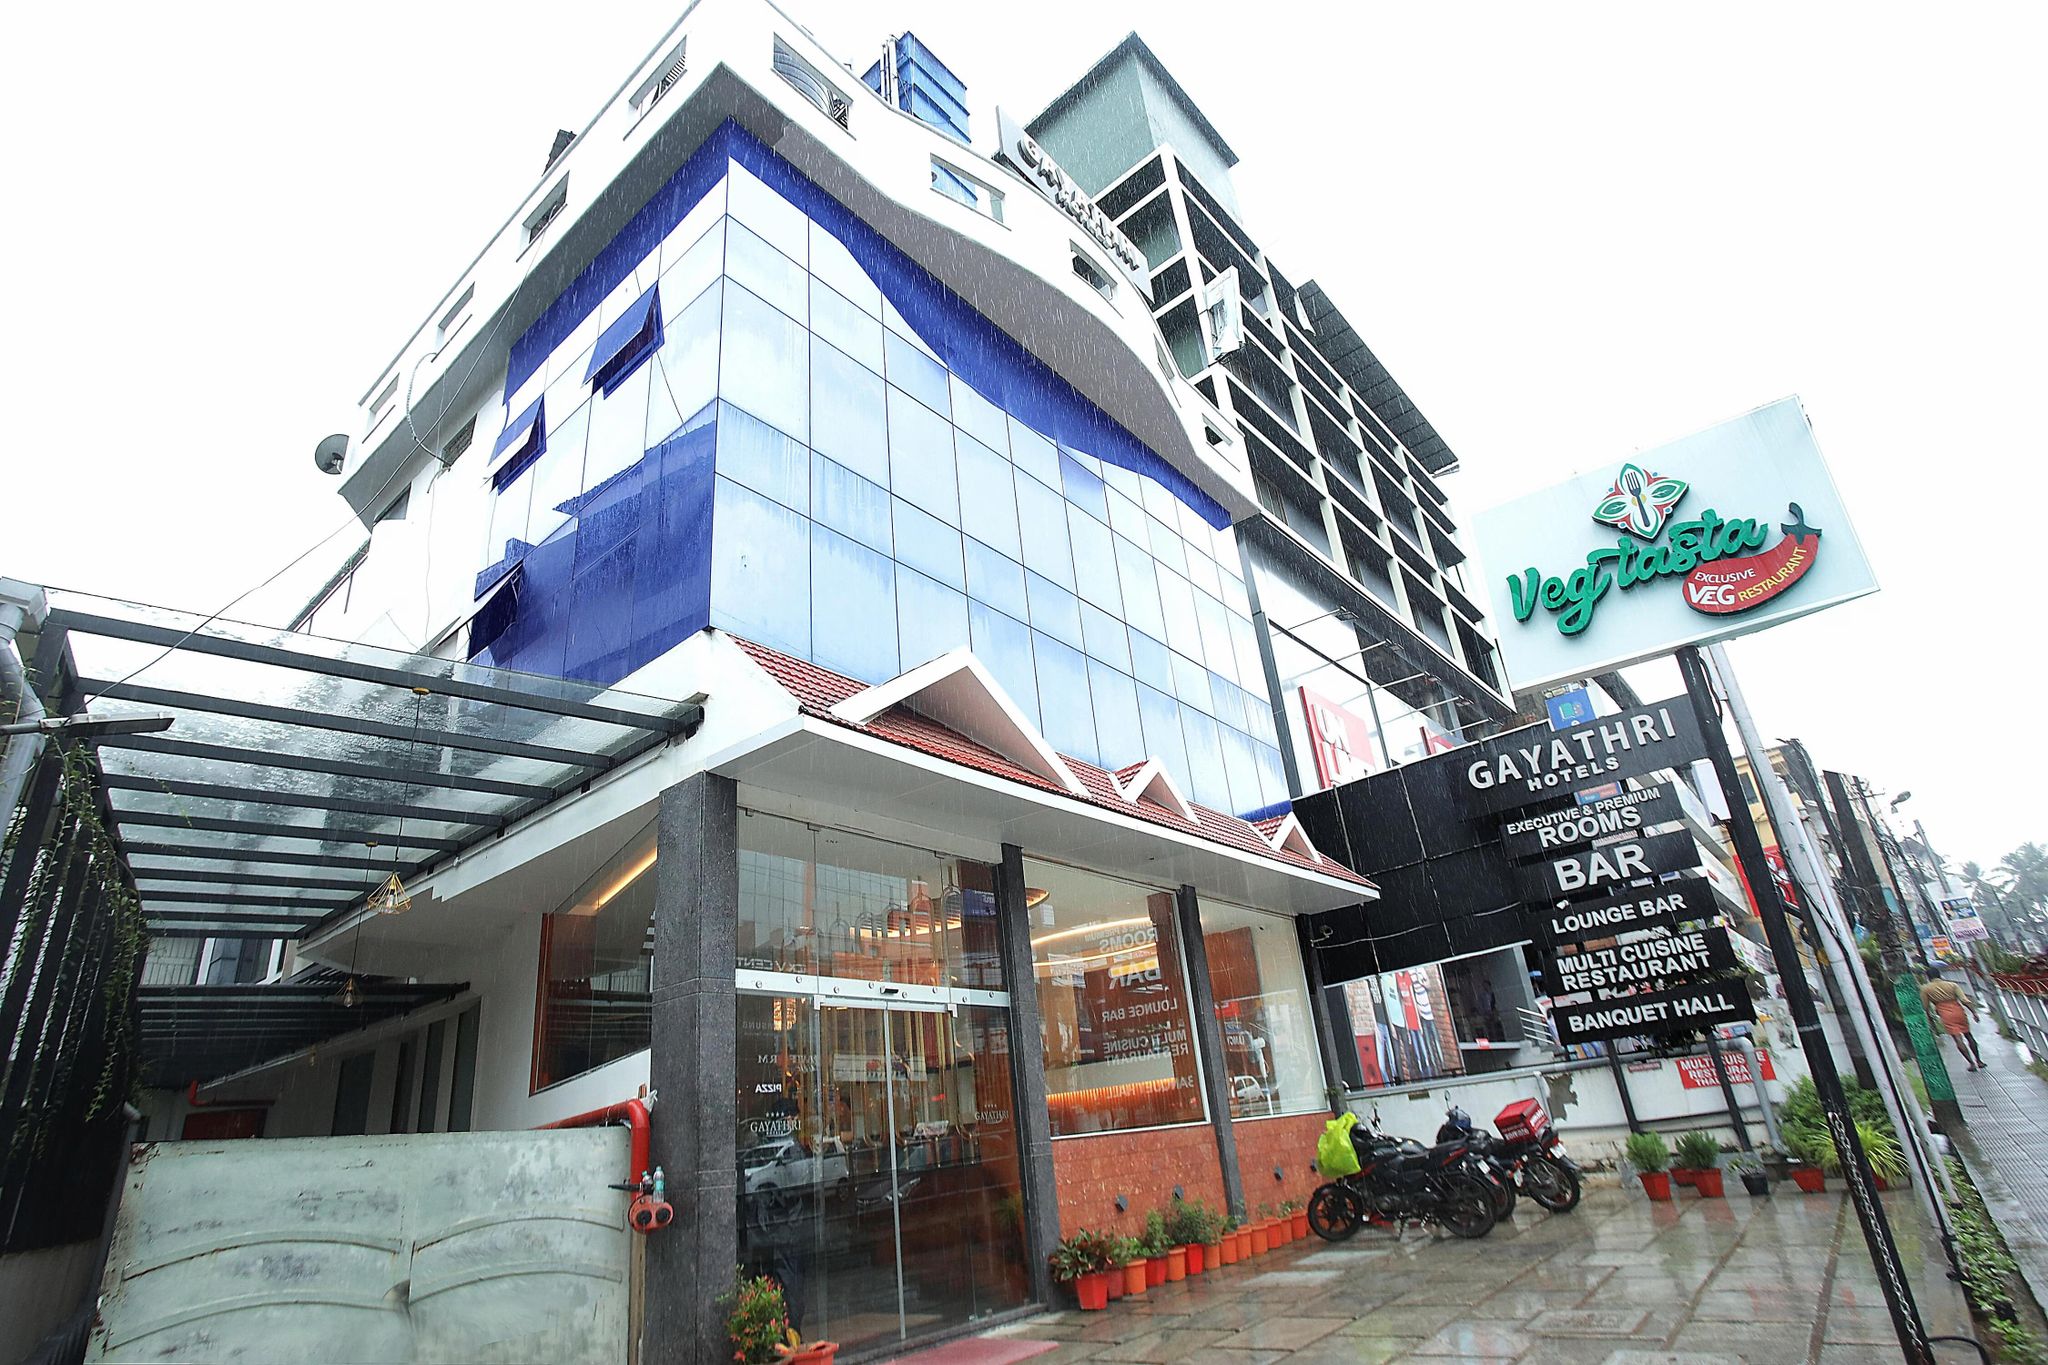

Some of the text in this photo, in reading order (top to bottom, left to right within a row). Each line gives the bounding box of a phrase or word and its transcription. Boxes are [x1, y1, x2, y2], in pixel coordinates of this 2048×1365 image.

[1687, 546, 1808, 606] VEG RESTAURANT
[1694, 568, 1757, 584] EXCLUSIVE
[1468, 707, 1676, 790] GAYATHRI
[1527, 757, 1620, 792] HOTELS
[1506, 804, 1581, 835] EXECUTIVE
[1579, 804, 1594, 817] &
[1596, 787, 1661, 814] PREMIUM
[1538, 805, 1643, 848] ROOMS
[1552, 843, 1653, 892] BAR
[1551, 893, 1687, 935] LOUNGE BAR
[1556, 932, 1708, 975] MULTI CUISINE
[1561, 950, 1711, 992] RESTAURANT
[1568, 993, 1736, 1033] BANQUET HALL
